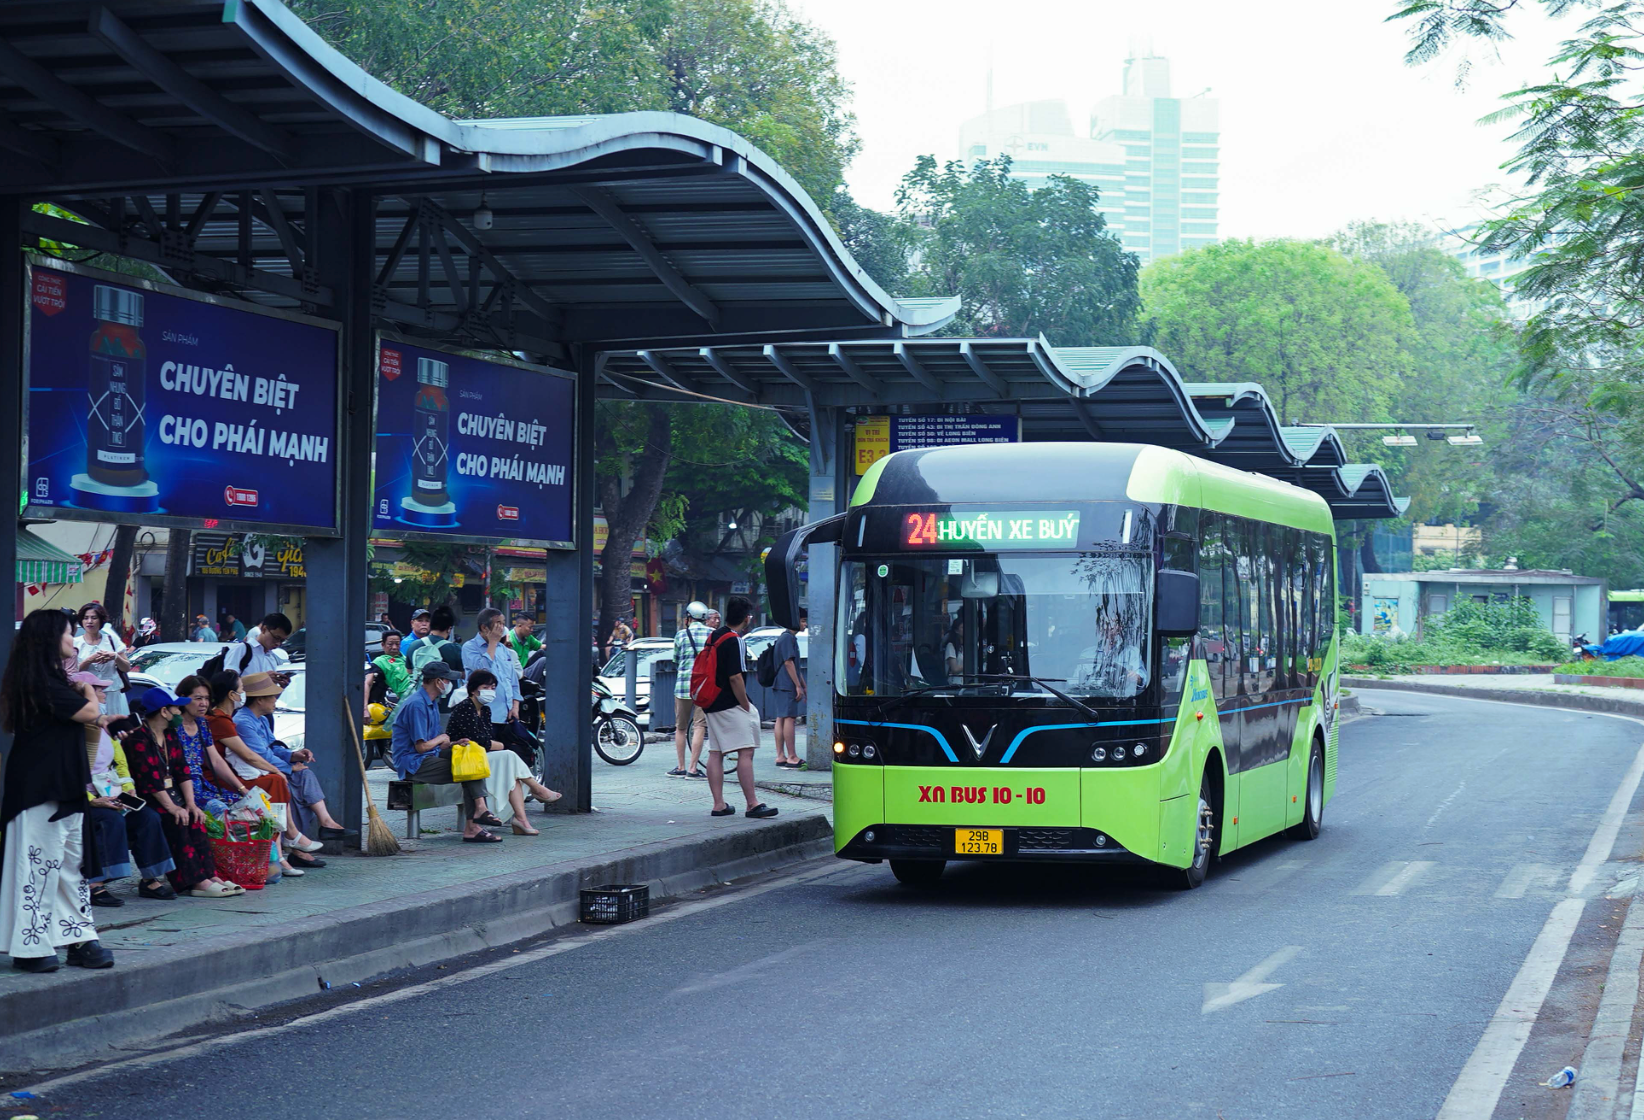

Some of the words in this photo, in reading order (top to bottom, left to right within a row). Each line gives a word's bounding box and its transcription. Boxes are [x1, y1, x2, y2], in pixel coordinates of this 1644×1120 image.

[1027, 142, 1048, 151] EVN
[48, 286, 62, 296] TIẾN
[33, 295, 49, 306] VƯỢT
[162, 329, 176, 343] SẢN
[178, 333, 199, 346] PHẨM
[160, 361, 250, 402] CHUYÊN
[253, 373, 299, 415] BIỆT
[458, 412, 514, 441] CHUYÊN
[516, 419, 547, 450] BIỆT
[159, 414, 208, 448] CHO
[212, 419, 265, 455] PHÁI
[268, 430, 329, 467] MẠNH
[456, 453, 487, 477] CHO
[490, 454, 524, 481] PHÁI
[526, 462, 565, 490] MẠNH
[908, 513, 938, 544] 24
[938, 513, 1002, 540] HUYẾN
[1008, 520, 1033, 539] XE
[918, 786, 945, 803] XN
[951, 787, 987, 804] BUS
[993, 787, 1012, 804] 10
[1026, 788, 1045, 804] 10
[968, 831, 989, 841] 29B
[962, 843, 997, 853] 123.78
